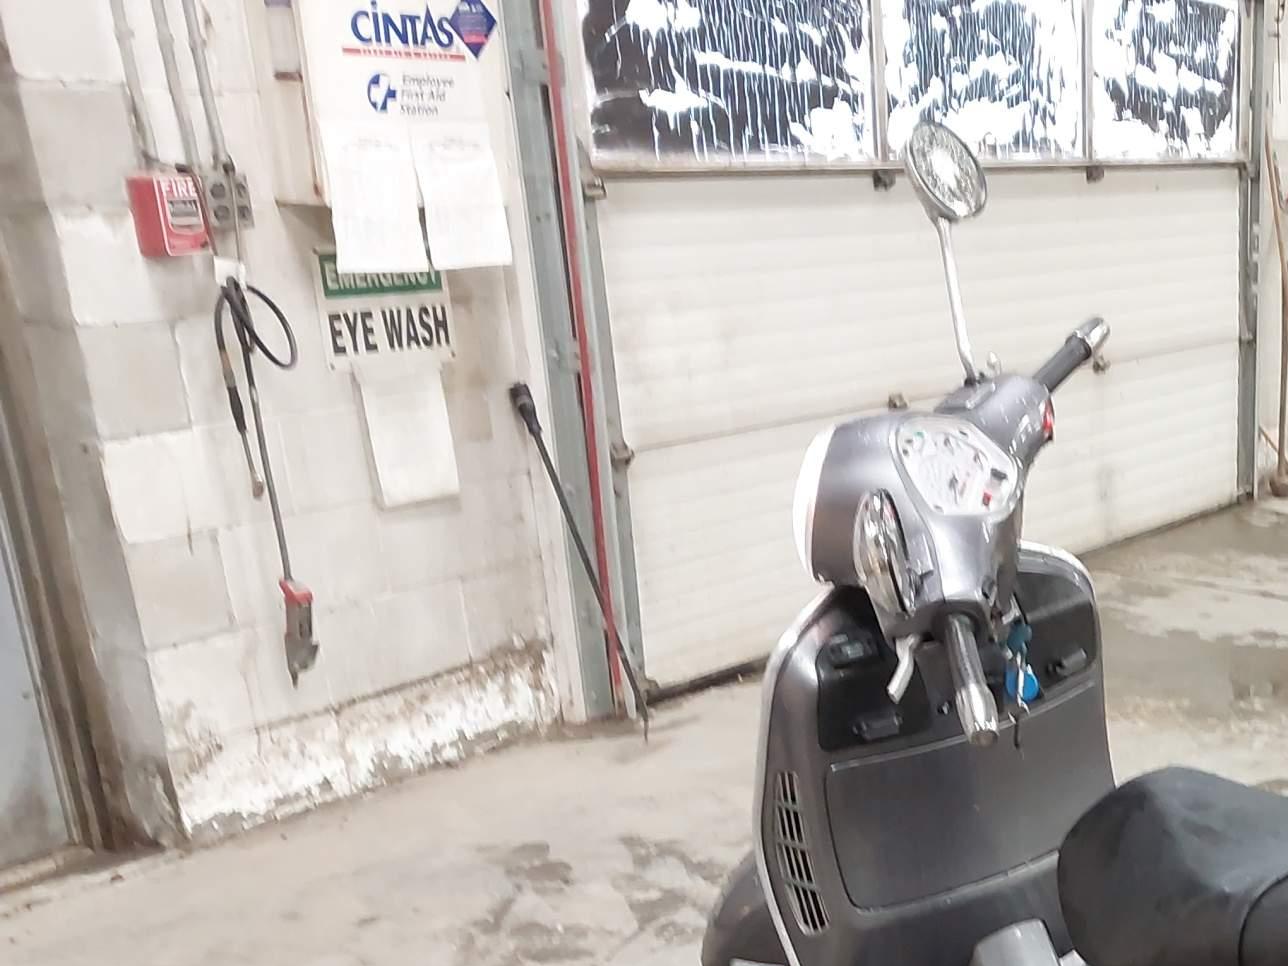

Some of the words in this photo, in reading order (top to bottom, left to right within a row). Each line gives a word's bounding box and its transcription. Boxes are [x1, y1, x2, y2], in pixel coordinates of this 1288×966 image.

[350, 0, 454, 48] CINTAS
[402, 74, 455, 90] Employee
[401, 88, 424, 101] First
[429, 90, 446, 102] Aid
[400, 104, 439, 116] Station
[328, 311, 379, 355] EYE
[381, 304, 450, 351] WASH
